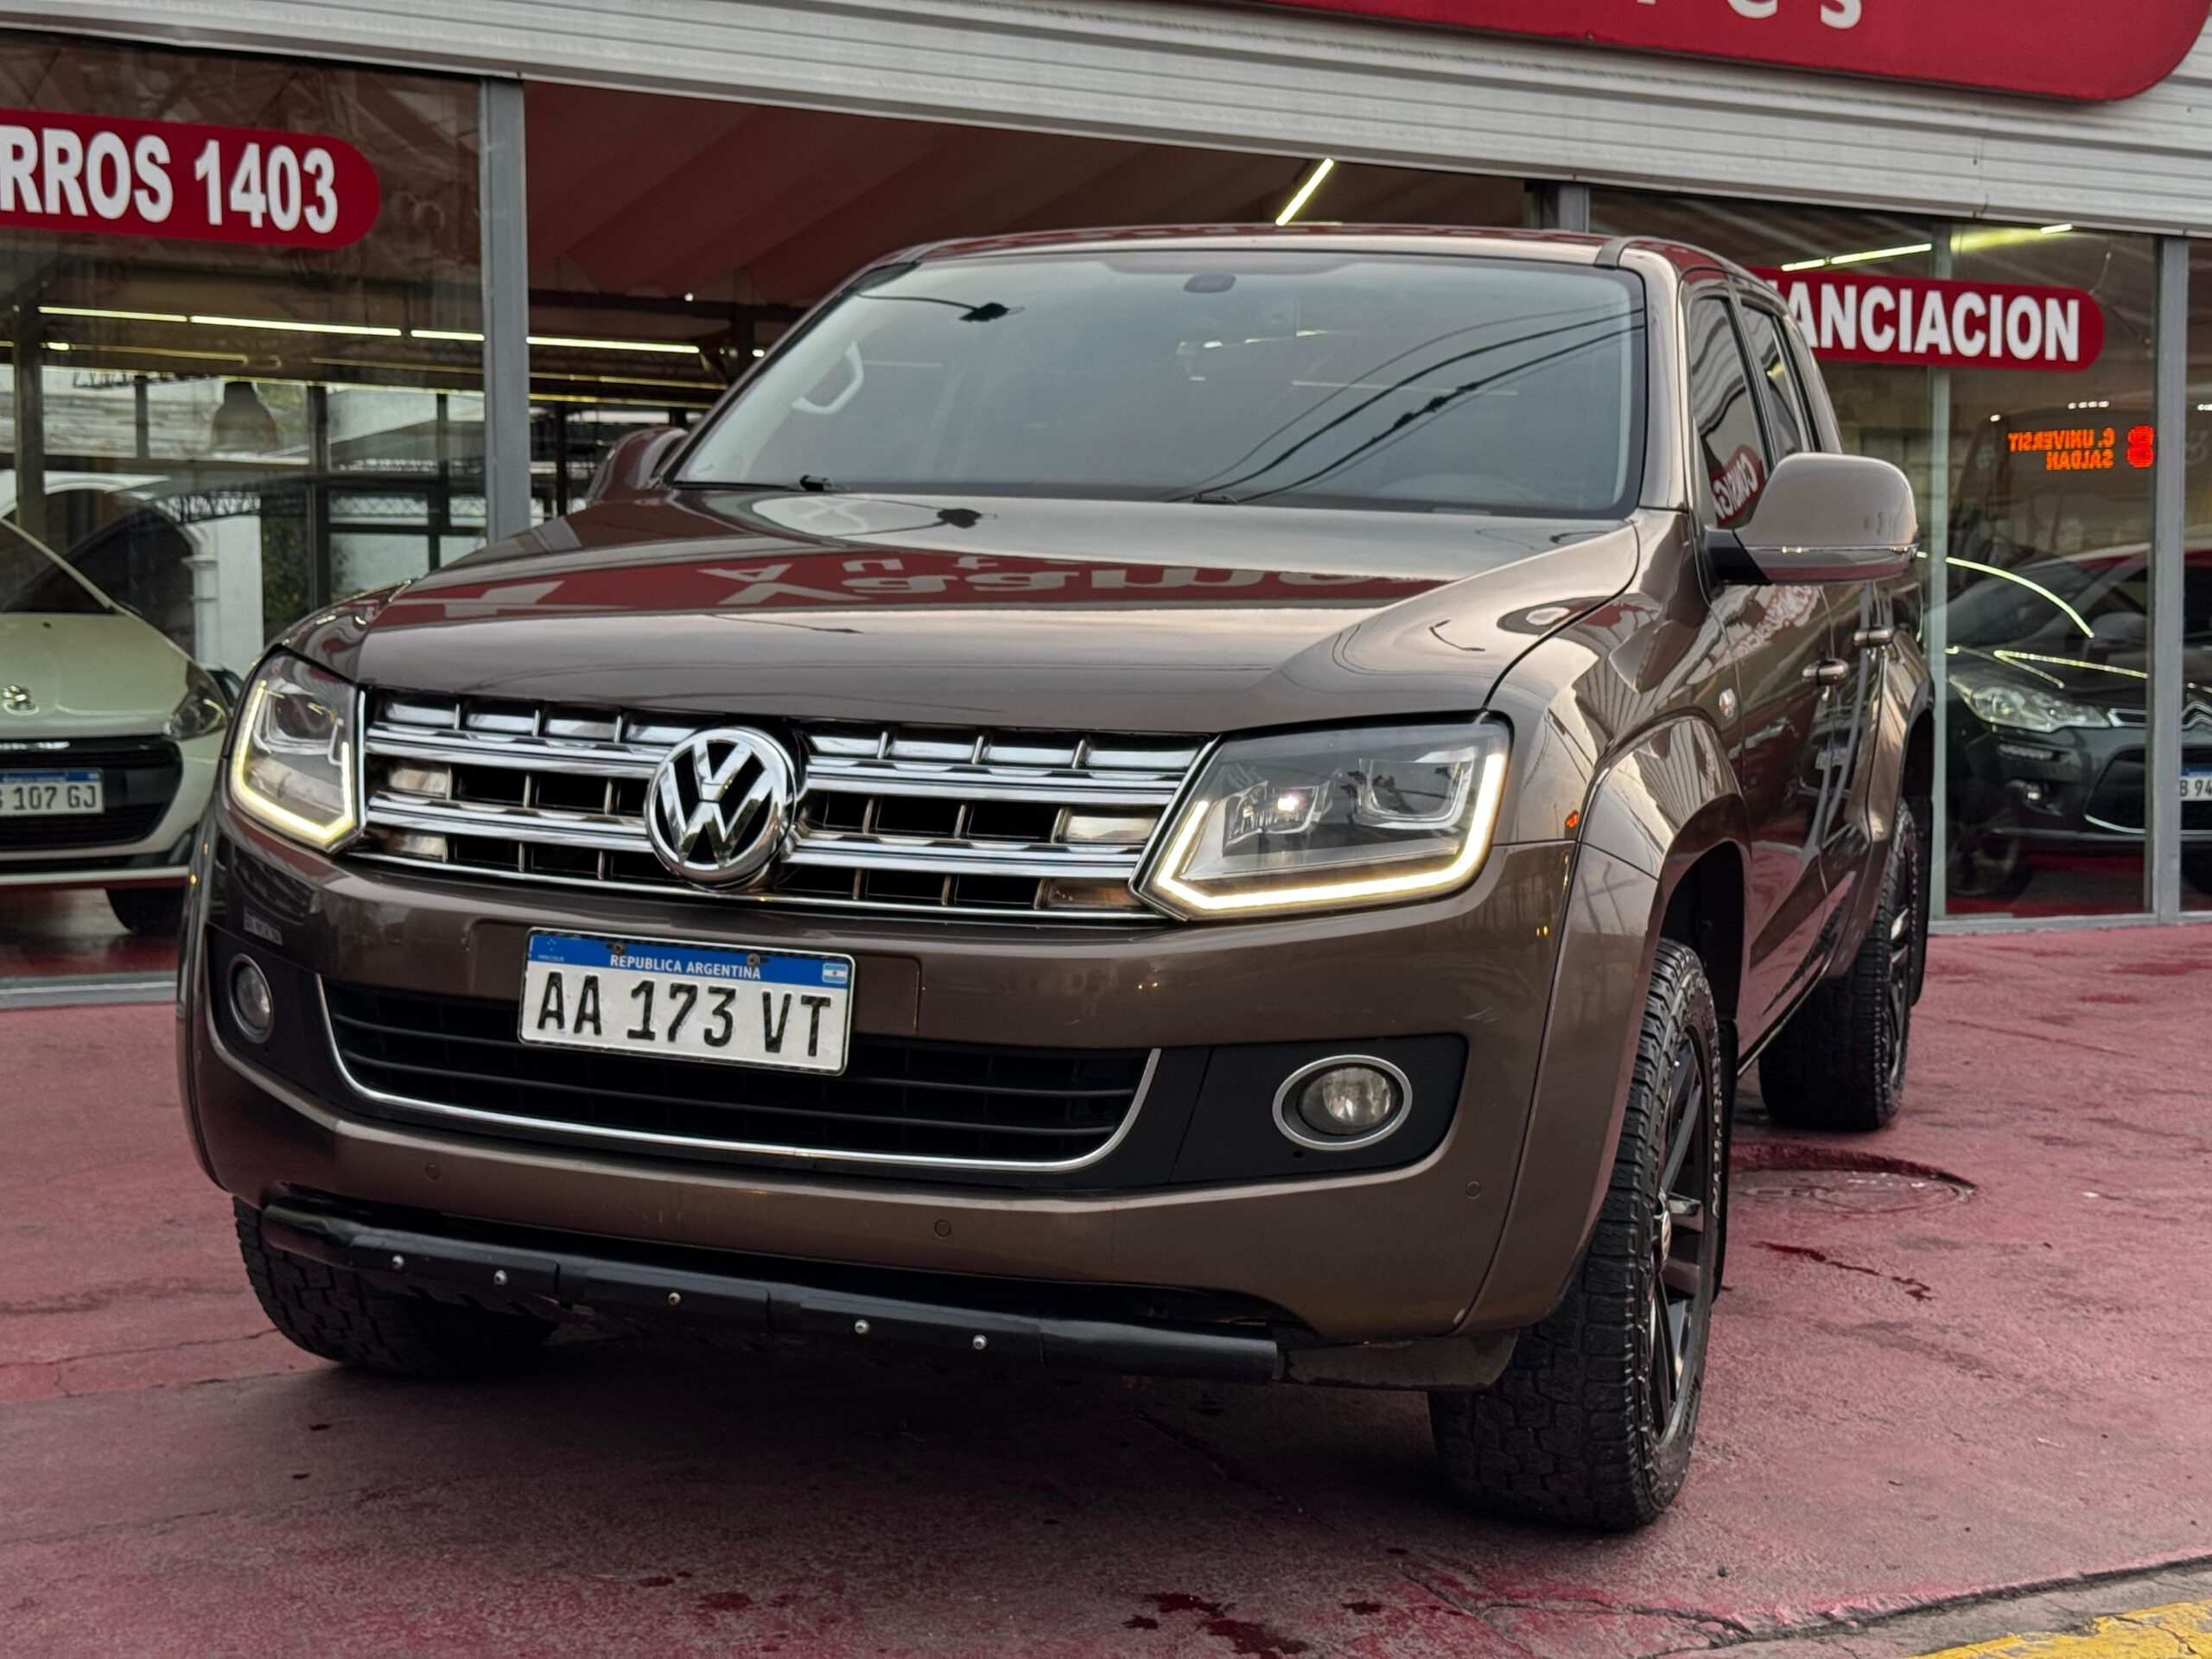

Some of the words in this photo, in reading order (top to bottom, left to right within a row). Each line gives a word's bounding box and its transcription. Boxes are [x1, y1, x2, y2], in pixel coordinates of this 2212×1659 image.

[0, 124, 173, 222] RROS
[194, 139, 338, 233] 1403
[1772, 280, 2079, 362] ANCIACION
[13, 785, 57, 810] 107
[67, 785, 96, 809] GJ
[610, 954, 682, 974] REPUBLICA
[686, 962, 761, 980] ARGENTINA
[537, 972, 601, 1035] AA
[627, 979, 736, 1046] 173
[762, 991, 830, 1057] VT
